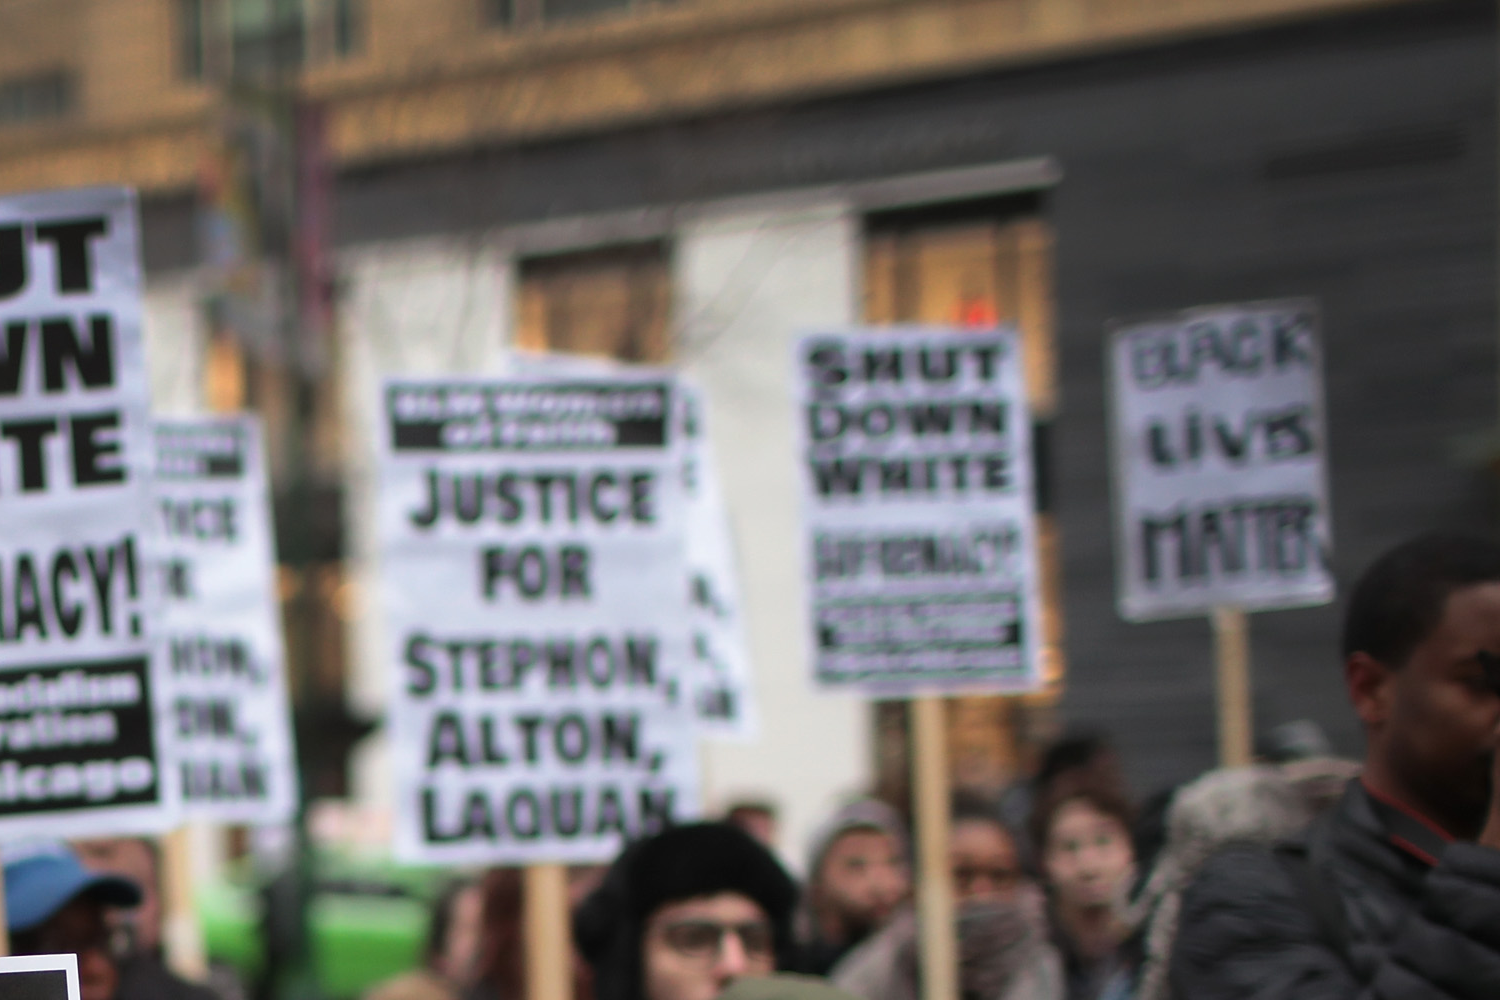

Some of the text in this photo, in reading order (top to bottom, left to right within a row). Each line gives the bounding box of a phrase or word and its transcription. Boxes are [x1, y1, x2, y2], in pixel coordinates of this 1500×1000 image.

[807, 342, 1002, 383] SHUT
[809, 401, 1009, 442] DOWN
[410, 470, 656, 530] JUSTICE
[809, 455, 1014, 498] WHITE
[480, 544, 593, 602] FOR
[407, 634, 677, 700] STEPHON,
[428, 711, 665, 774] ALTON,
